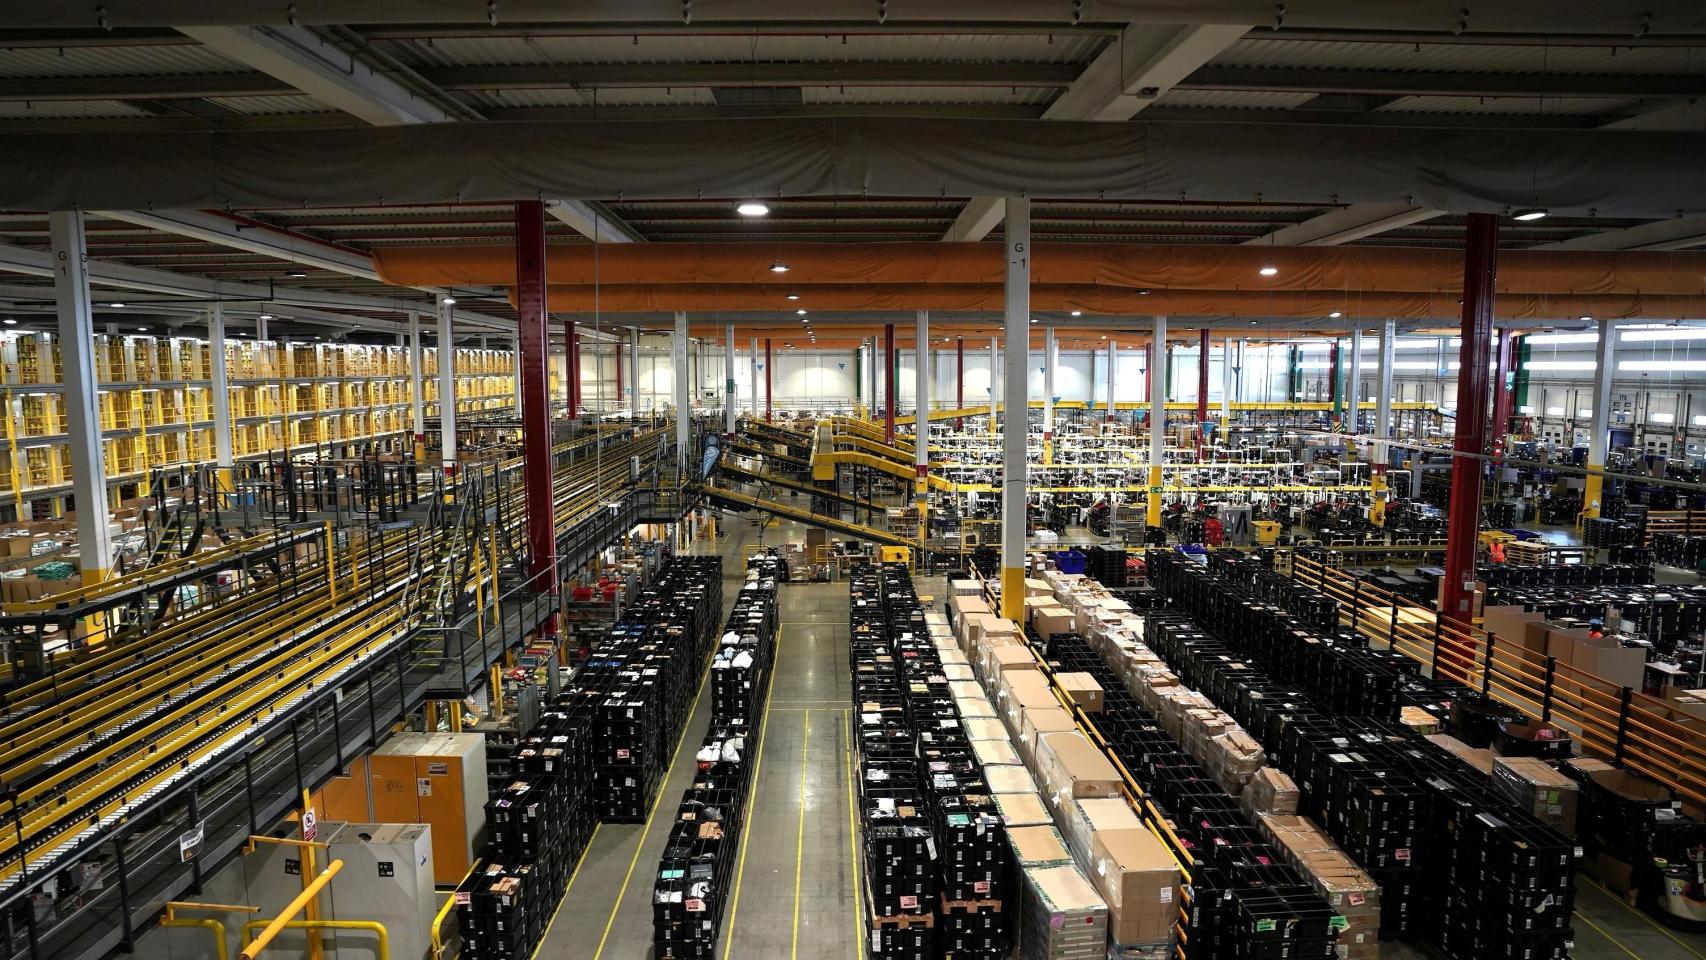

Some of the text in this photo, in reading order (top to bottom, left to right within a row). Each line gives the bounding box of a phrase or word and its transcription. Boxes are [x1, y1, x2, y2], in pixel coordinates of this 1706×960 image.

[1014, 242, 1024, 253] G
[58, 251, 67, 261] G
[81, 252, 88, 262] G
[62, 266, 66, 276] 1
